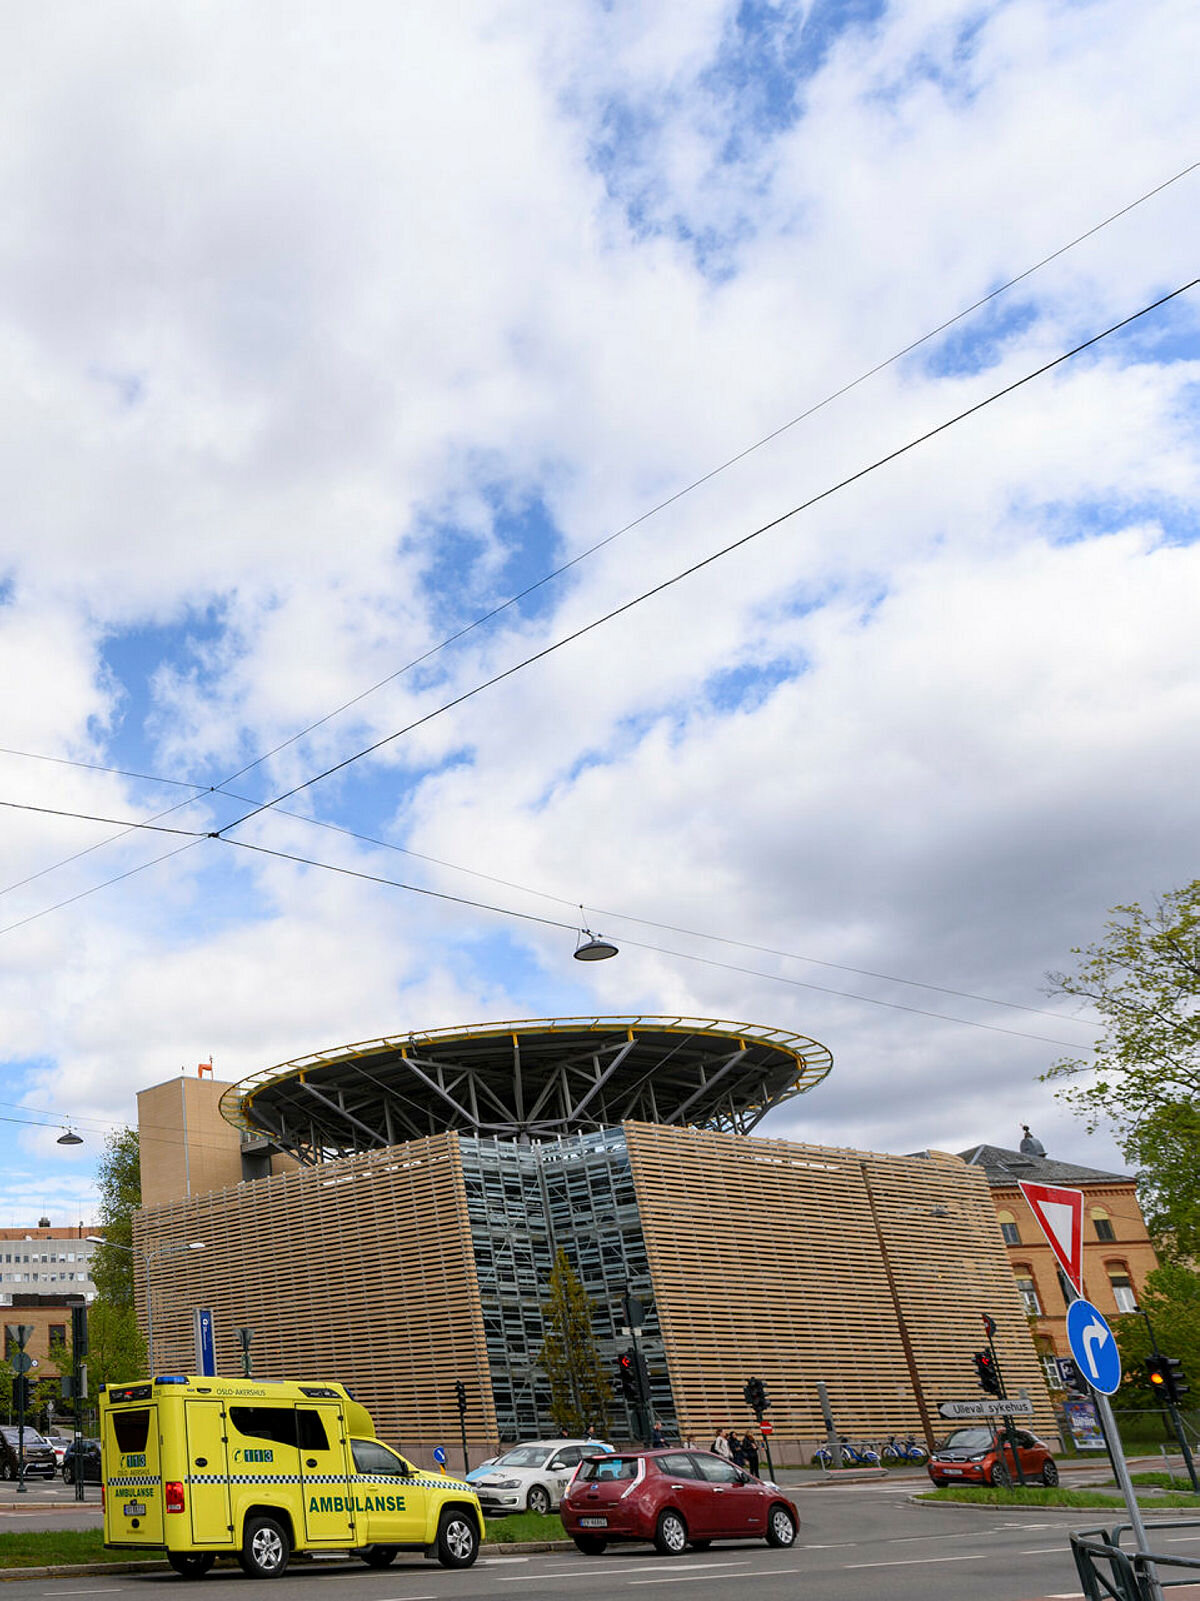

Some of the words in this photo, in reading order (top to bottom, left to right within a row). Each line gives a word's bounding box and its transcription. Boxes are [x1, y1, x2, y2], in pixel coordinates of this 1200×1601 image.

[988, 1402, 1029, 1415] sykehus
[127, 1455, 145, 1467] 113
[245, 1450, 273, 1462] 113
[115, 1488, 154, 1497] AMBULANSE
[309, 1496, 406, 1513] AMBULANSE
